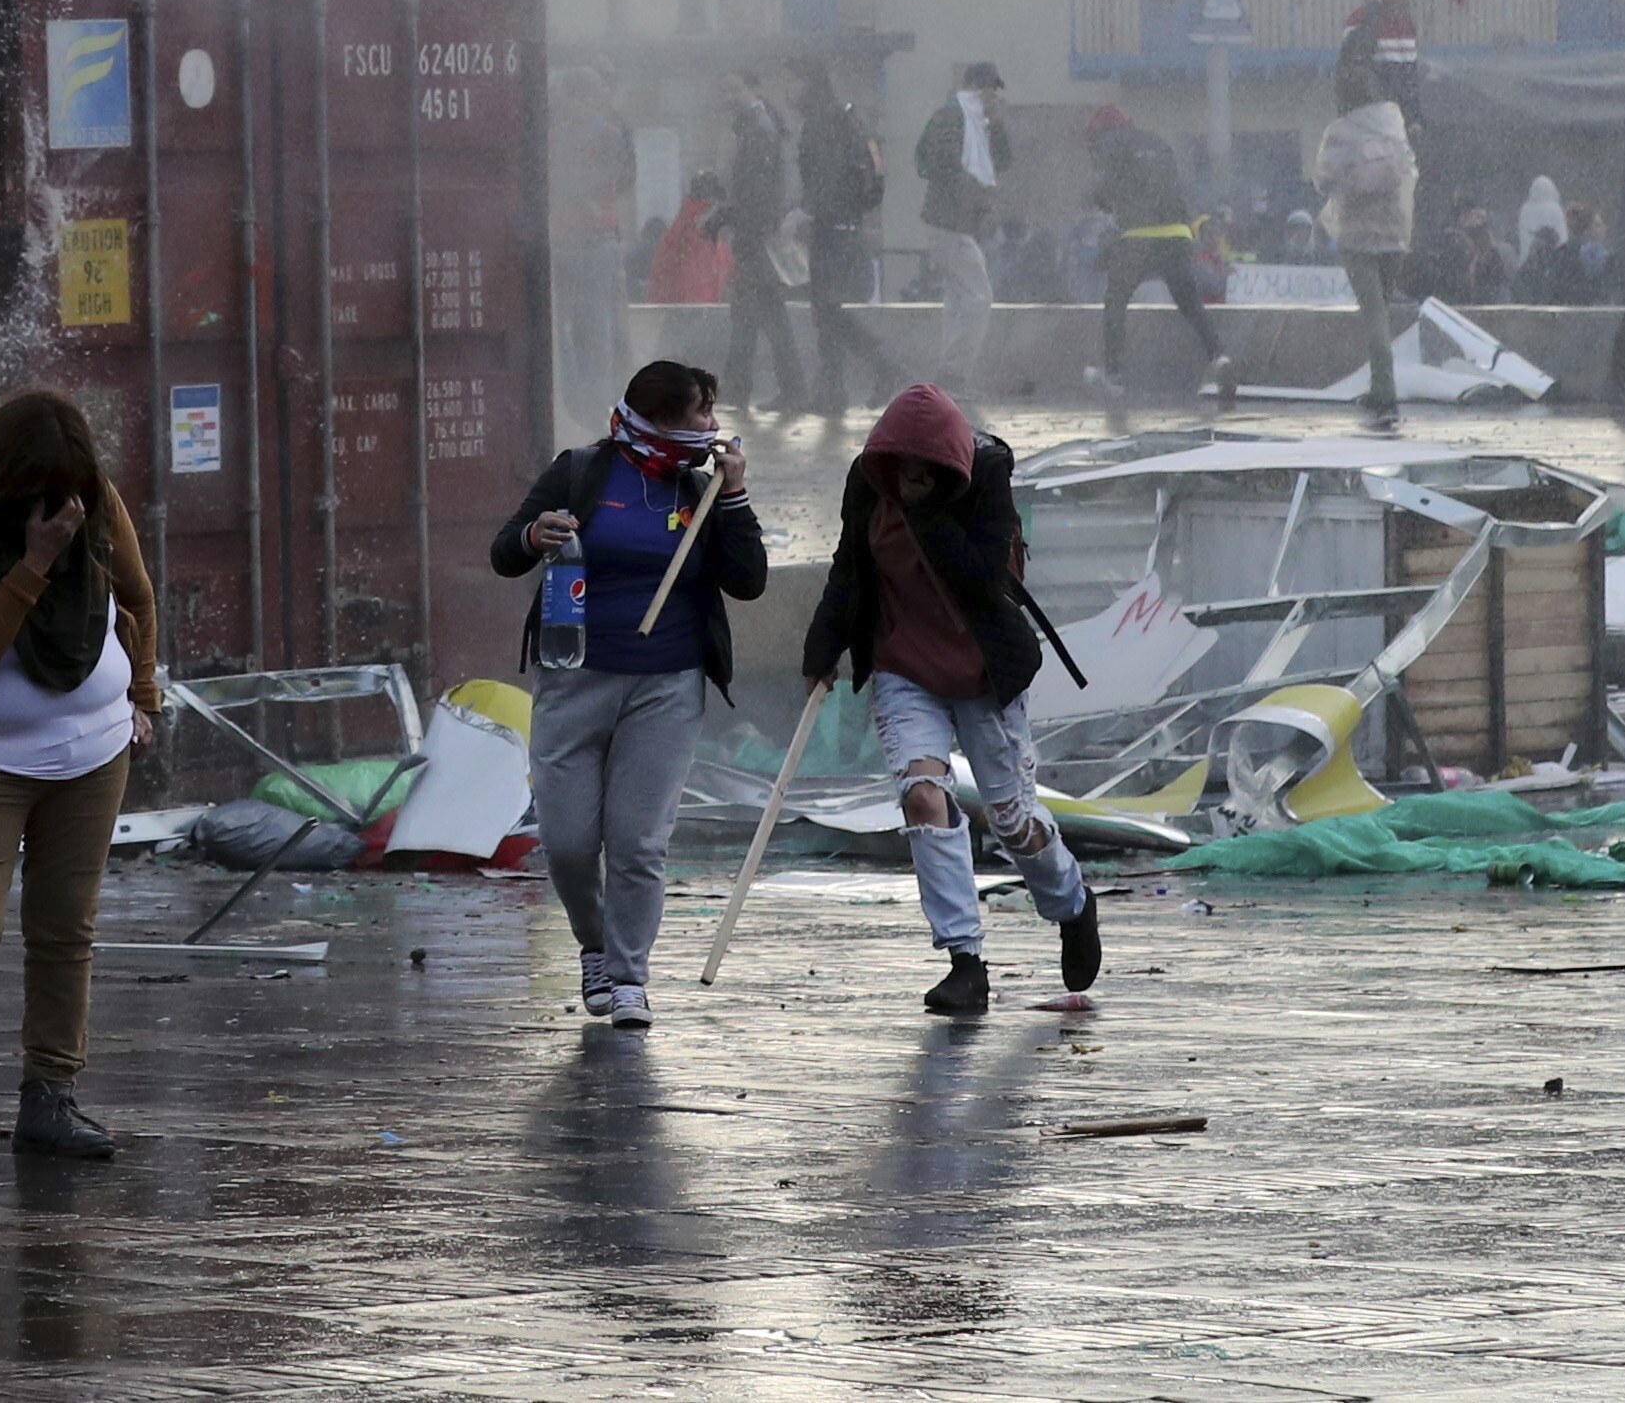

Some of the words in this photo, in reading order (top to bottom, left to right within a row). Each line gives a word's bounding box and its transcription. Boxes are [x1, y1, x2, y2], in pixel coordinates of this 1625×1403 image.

[343, 44, 392, 76] FSCU
[418, 43, 493, 75] 624026
[78, 291, 112, 315] HIGH
